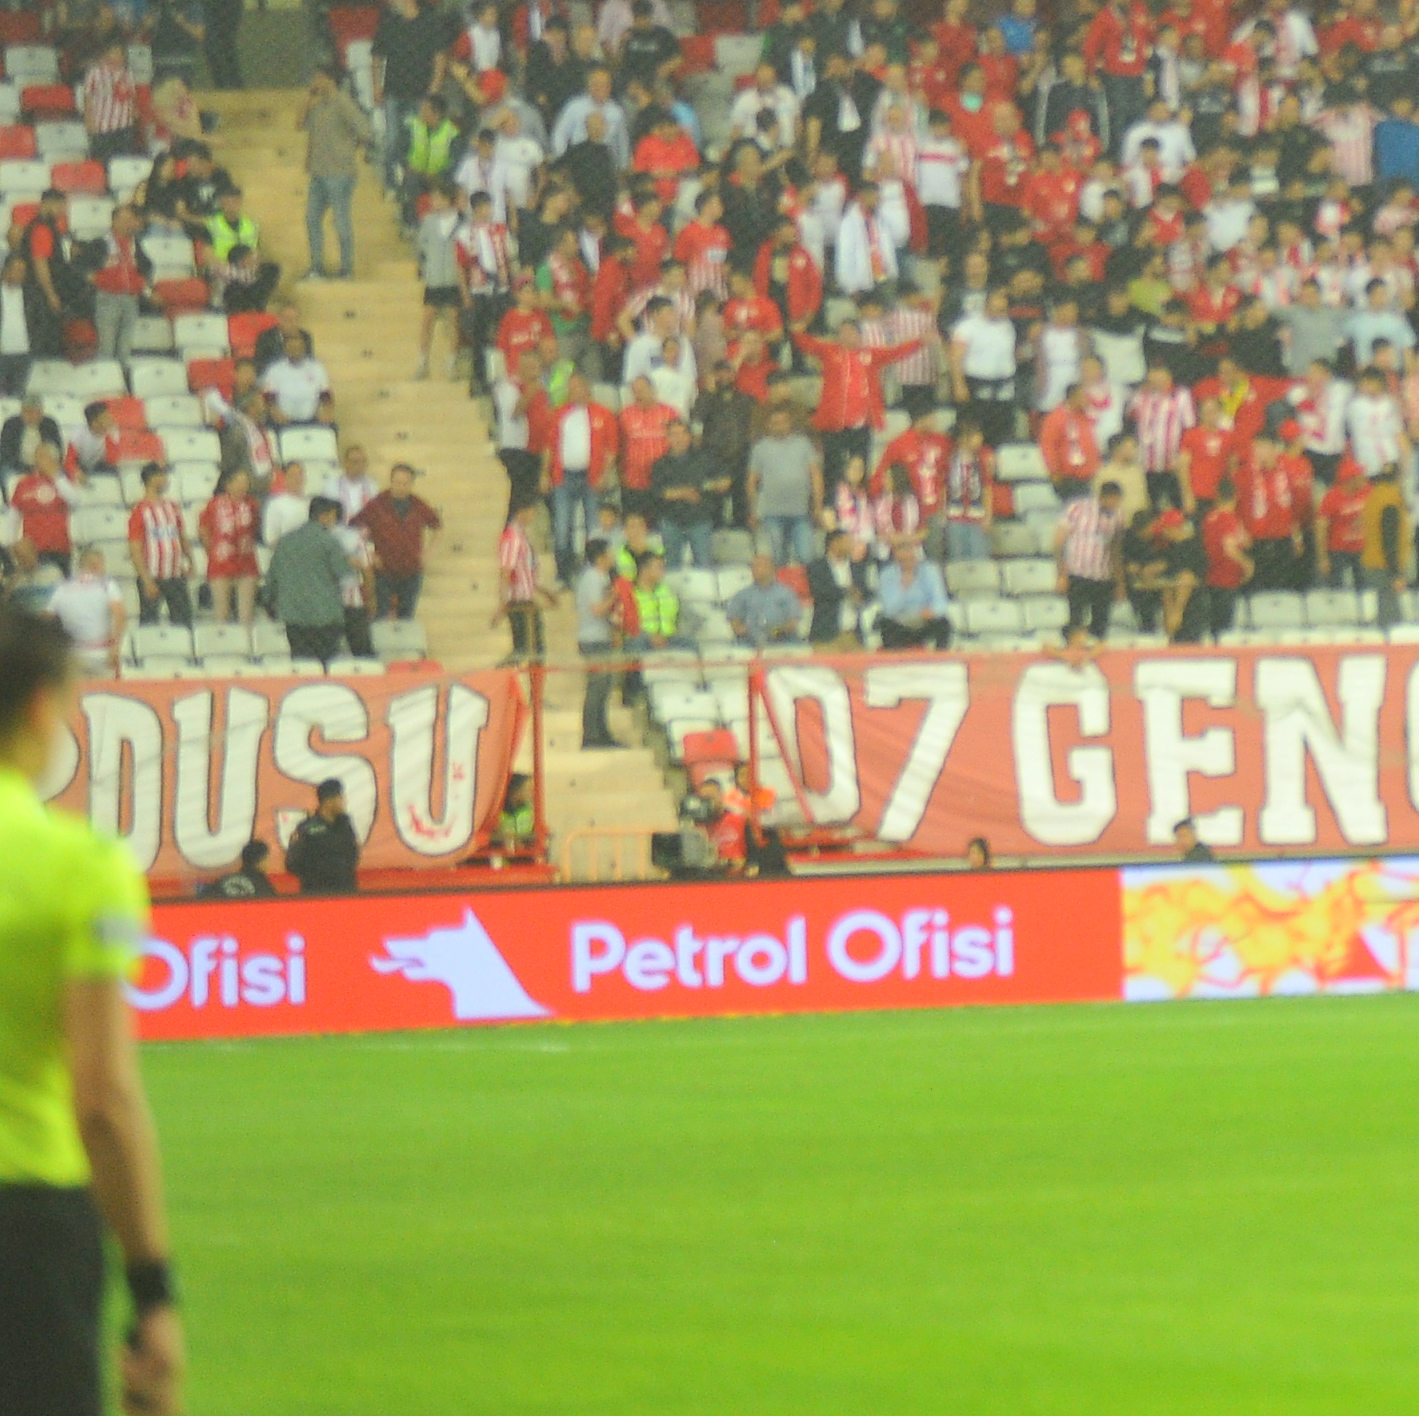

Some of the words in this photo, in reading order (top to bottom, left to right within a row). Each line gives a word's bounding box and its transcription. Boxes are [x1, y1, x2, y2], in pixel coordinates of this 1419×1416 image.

[45, 680, 489, 875] DUSU
[570, 915, 808, 994] Petrol
[827, 905, 1014, 982] Ofisi
